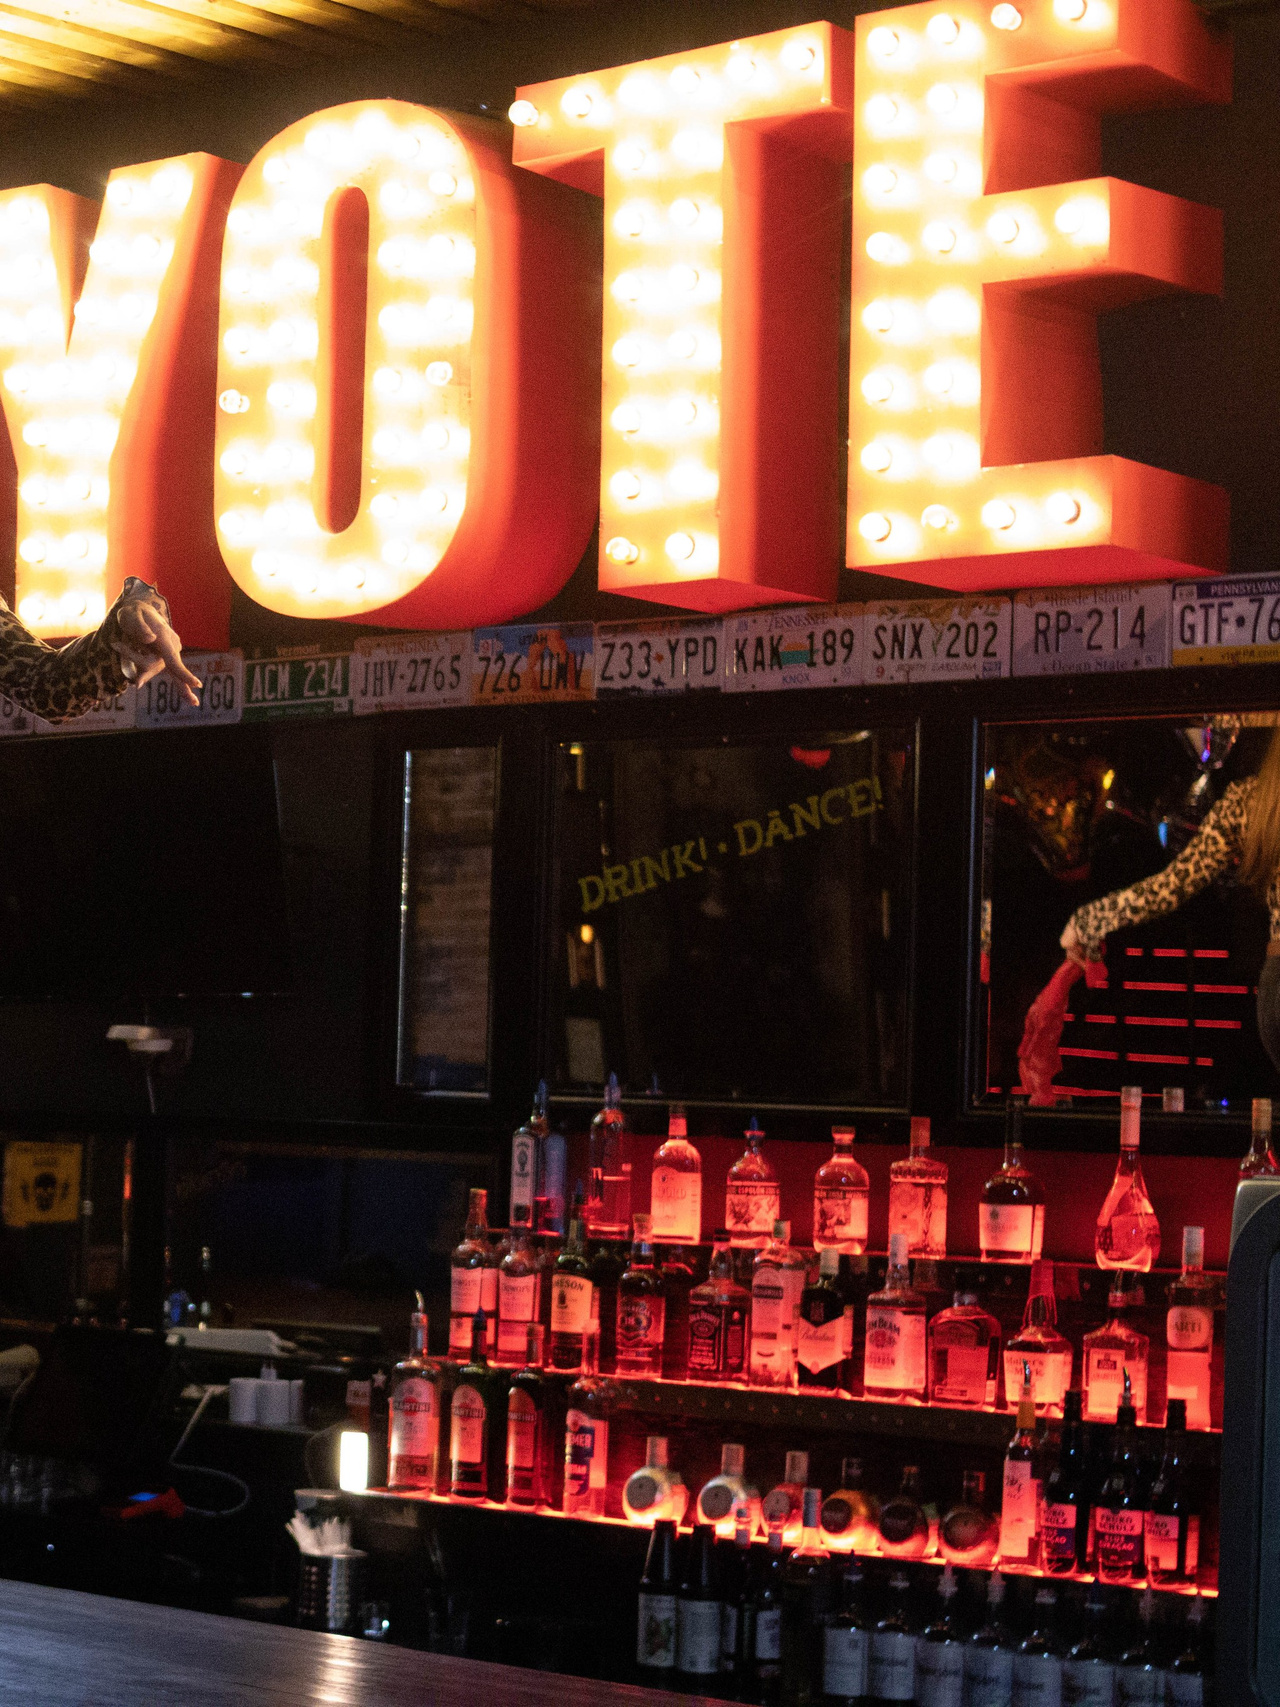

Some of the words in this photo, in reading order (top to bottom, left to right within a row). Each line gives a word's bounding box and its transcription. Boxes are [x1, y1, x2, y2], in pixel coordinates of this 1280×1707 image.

[734, 636, 783, 675] KAK
[806, 629, 855, 668] 189
[872, 624, 925, 661] SNX
[946, 621, 998, 659] 202
[1034, 605, 1146, 654] RP-214
[250, 662, 291, 703] ACM
[303, 657, 343, 698] 234
[479, 656, 521, 695] 726
[577, 836, 708, 914] DRINK!
[733, 775, 885, 858] DANCE!
